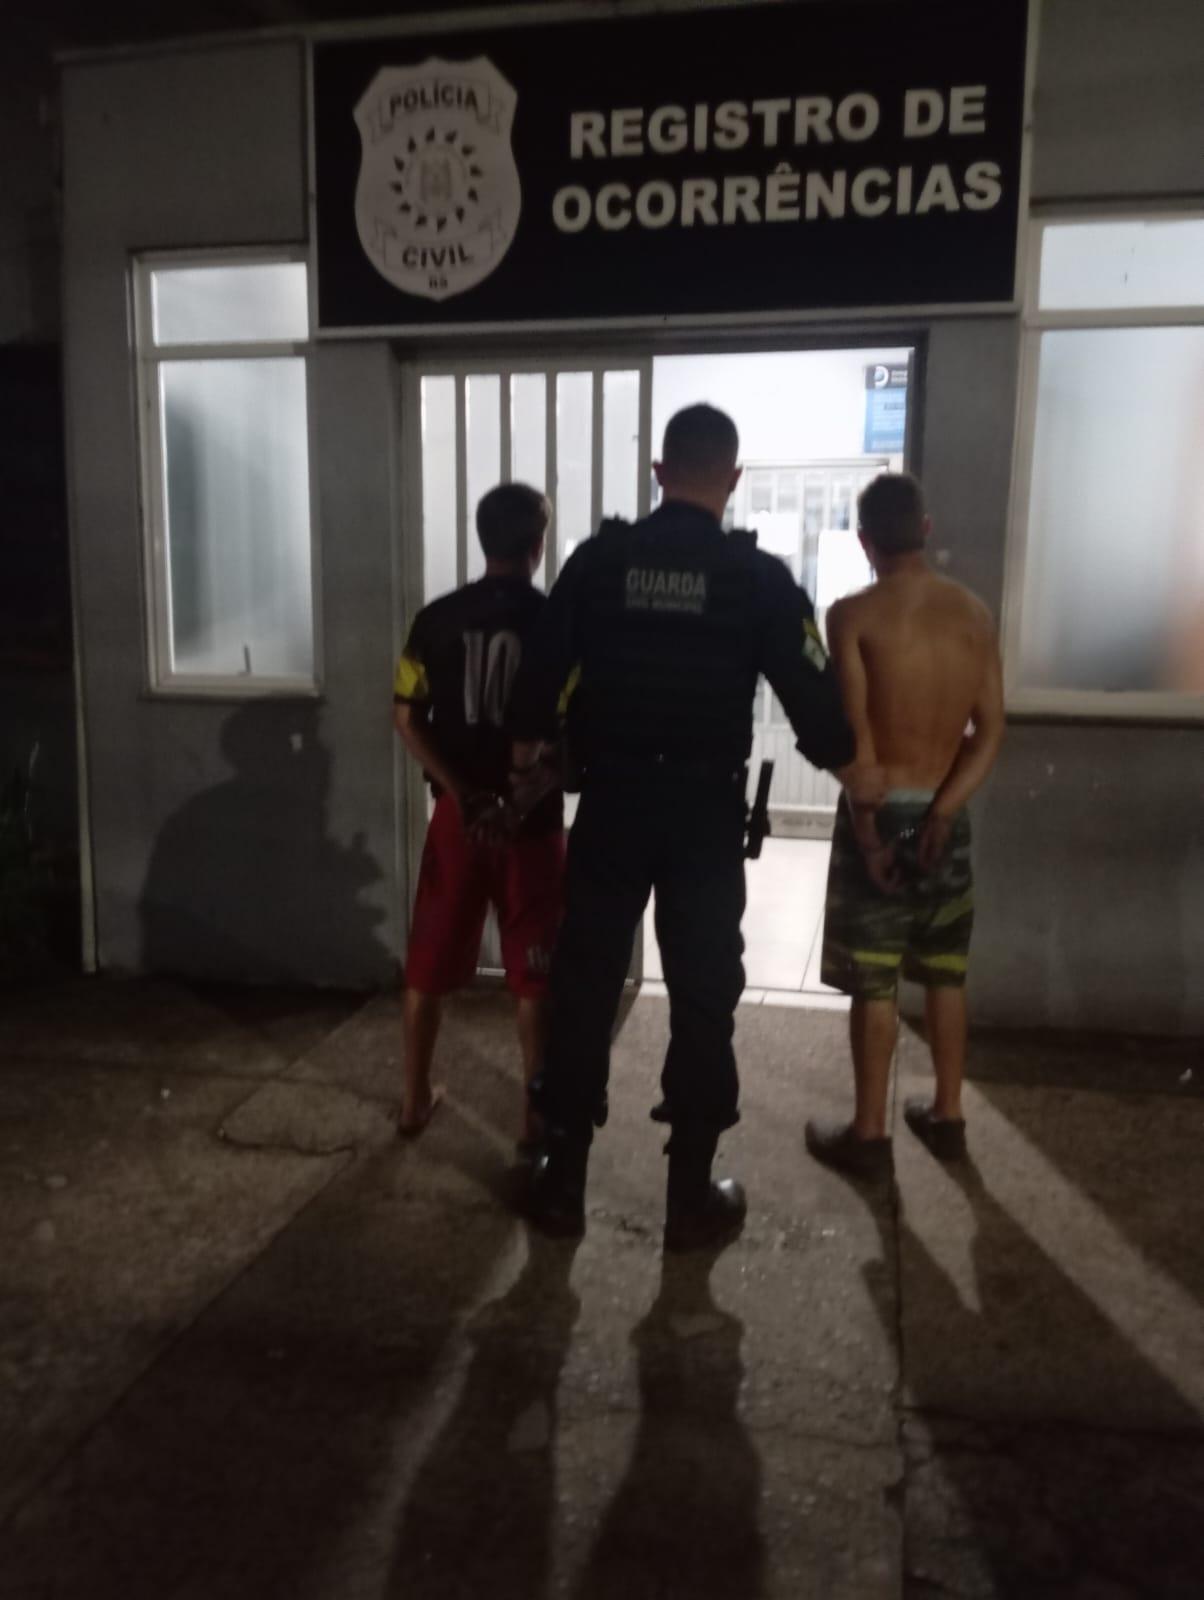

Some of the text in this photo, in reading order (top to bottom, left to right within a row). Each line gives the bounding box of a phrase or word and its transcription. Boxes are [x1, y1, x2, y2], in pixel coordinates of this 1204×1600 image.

[390, 81, 479, 118] POLÍCIA
[570, 85, 988, 160] REGISTRO DE
[552, 161, 1003, 233] OCORRÊNCIAS
[402, 242, 474, 269] CIVIL
[626, 567, 706, 598] GUARDA
[462, 628, 522, 727] 10
